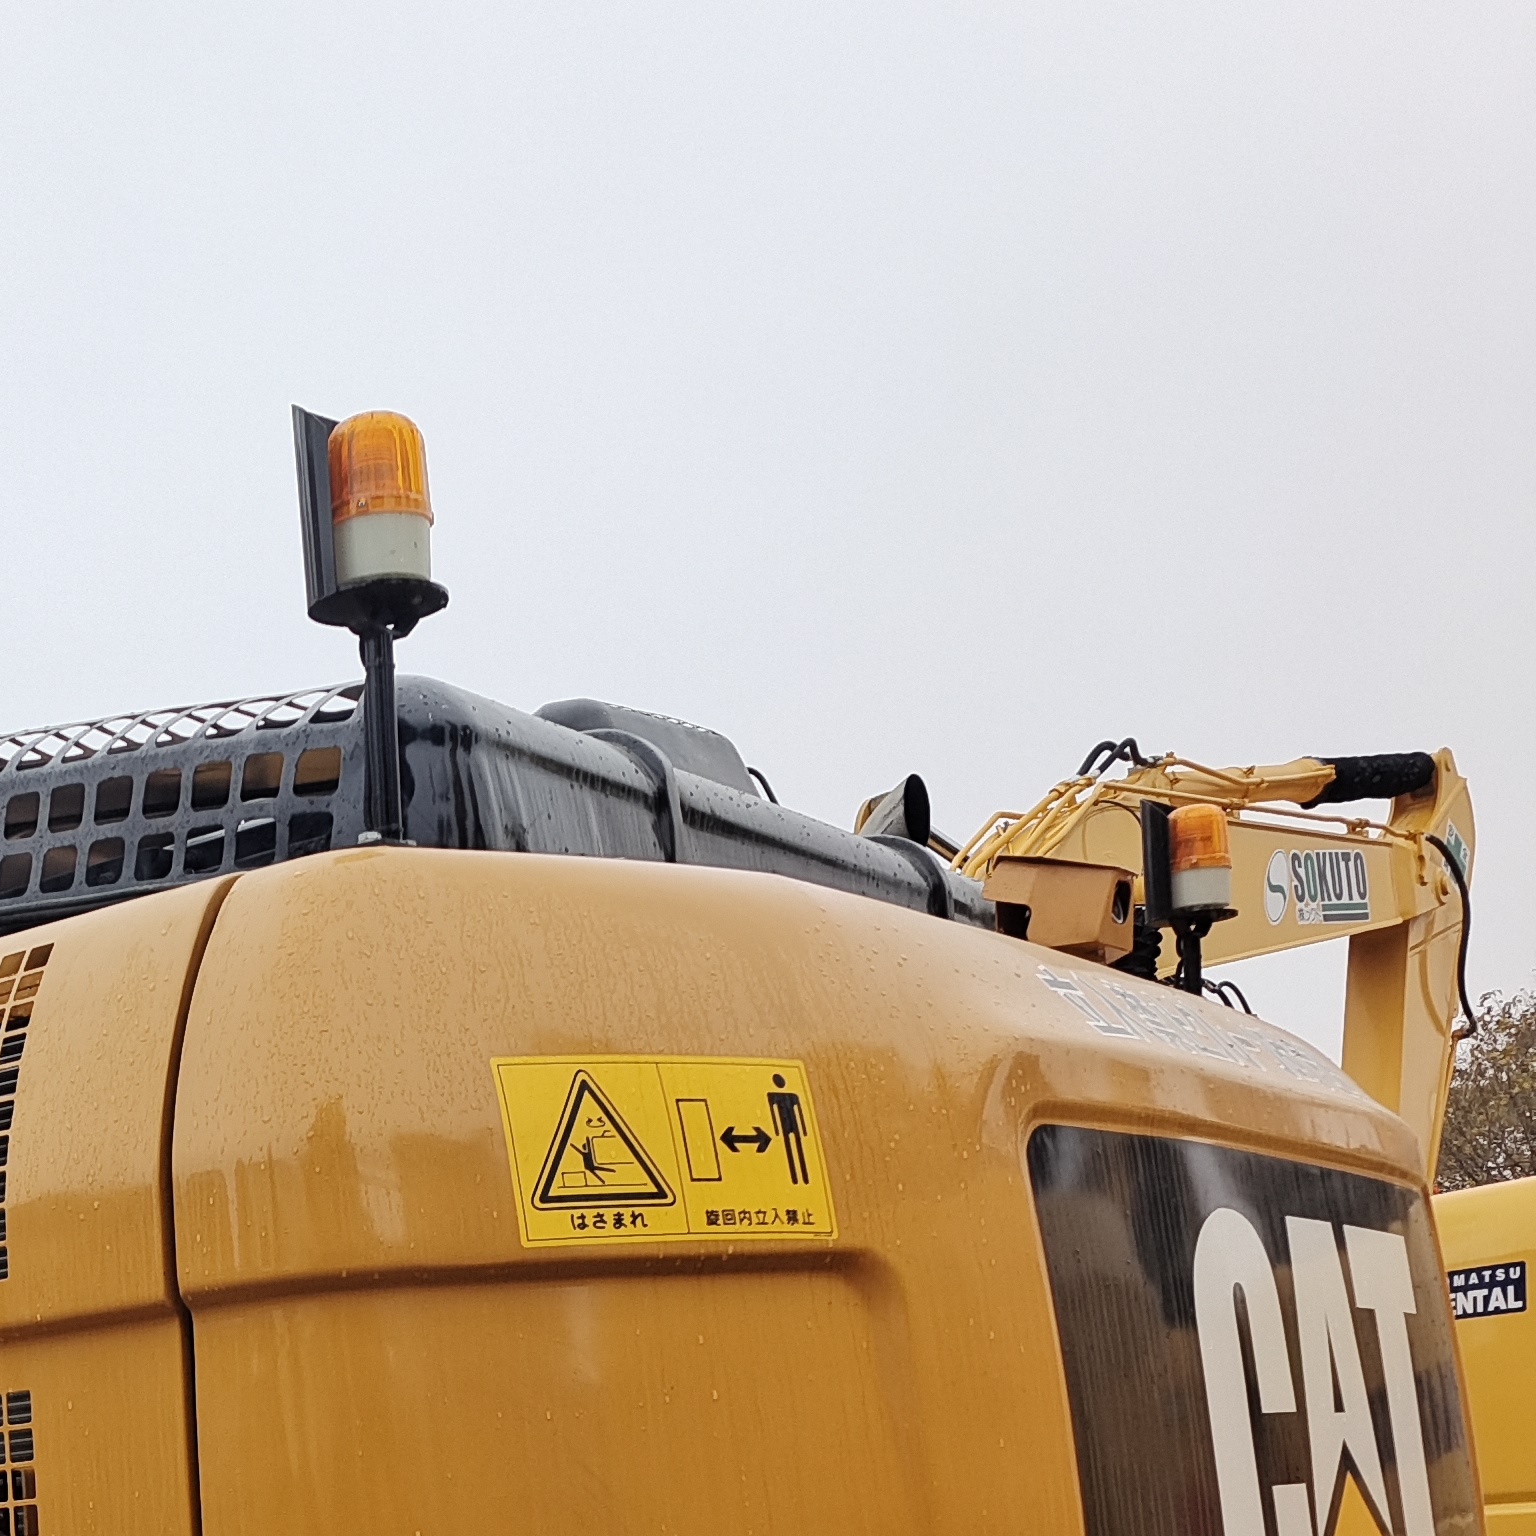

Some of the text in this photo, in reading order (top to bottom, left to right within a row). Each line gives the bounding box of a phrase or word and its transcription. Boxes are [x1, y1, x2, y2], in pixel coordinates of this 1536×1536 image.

[1291, 851, 1368, 903] SOKUTO
[570, 1211, 649, 1230] はさまれ
[705, 1208, 816, 1227] 旋回内立入禁止
[1446, 1266, 1521, 1287] MATSU
